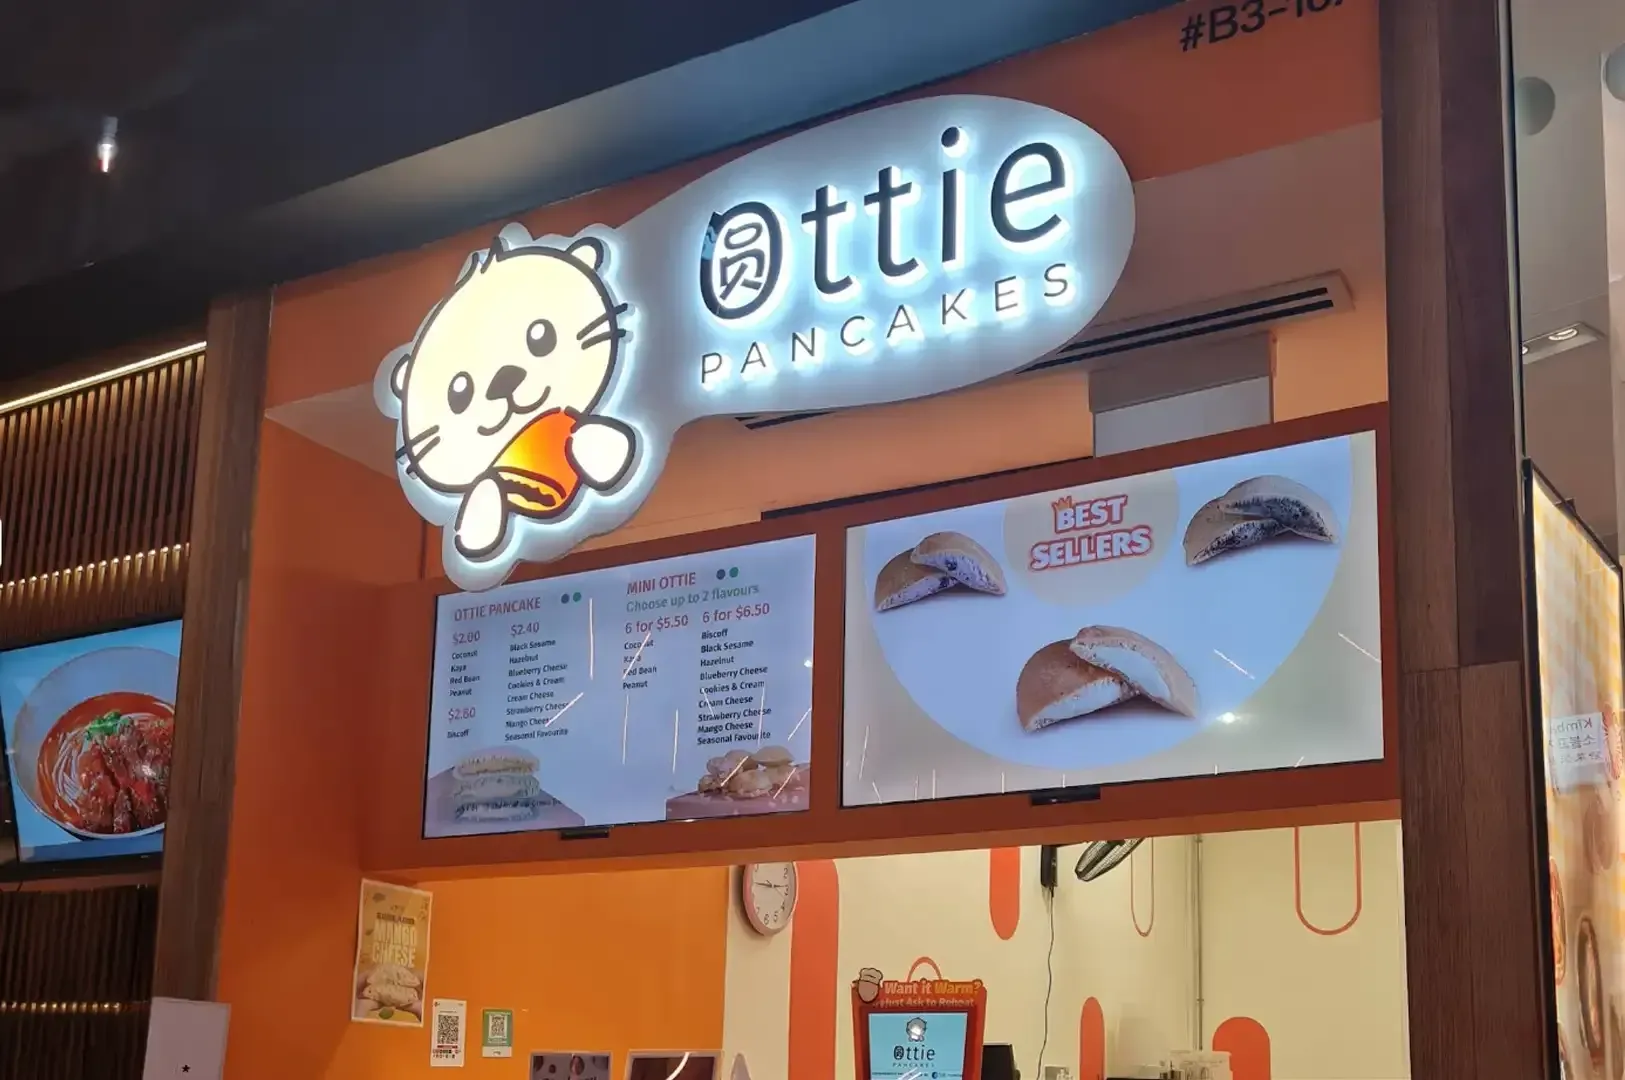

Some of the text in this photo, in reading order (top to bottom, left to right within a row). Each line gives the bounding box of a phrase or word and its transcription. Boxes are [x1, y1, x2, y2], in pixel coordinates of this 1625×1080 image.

[700, 126, 1066, 320] Ottie
[701, 263, 1068, 383] PANCAKES
[1055, 496, 1128, 533] BEST
[1030, 526, 1152, 571] SELLERS
[627, 572, 696, 595] MINI OTTIE
[626, 584, 760, 613] Choose up to 2 flavours
[454, 597, 541, 622] OTTIE PANCAKE
[702, 602, 770, 624] 6 for $6.50
[511, 621, 540, 638] $2.40
[625, 614, 689, 635] 6 for $5.50
[701, 628, 729, 640] Biscoff
[700, 639, 754, 654] Black Sesame
[700, 655, 735, 668] Hazelnut
[508, 665, 541, 678] Blueberry
[700, 665, 768, 682] Blueberry Cheese
[622, 679, 649, 691] Peanut
[731, 681, 739, 692] &
[739, 678, 765, 690] Cream
[529, 689, 554, 701] Cheese
[724, 694, 754, 707] Cheese
[698, 709, 742, 723] Strawberry
[697, 720, 754, 735] Mango Cheese
[697, 734, 732, 746] Seasonal
[884, 980, 981, 996] Want it Warm?
[893, 1044, 936, 1061] Ottie
